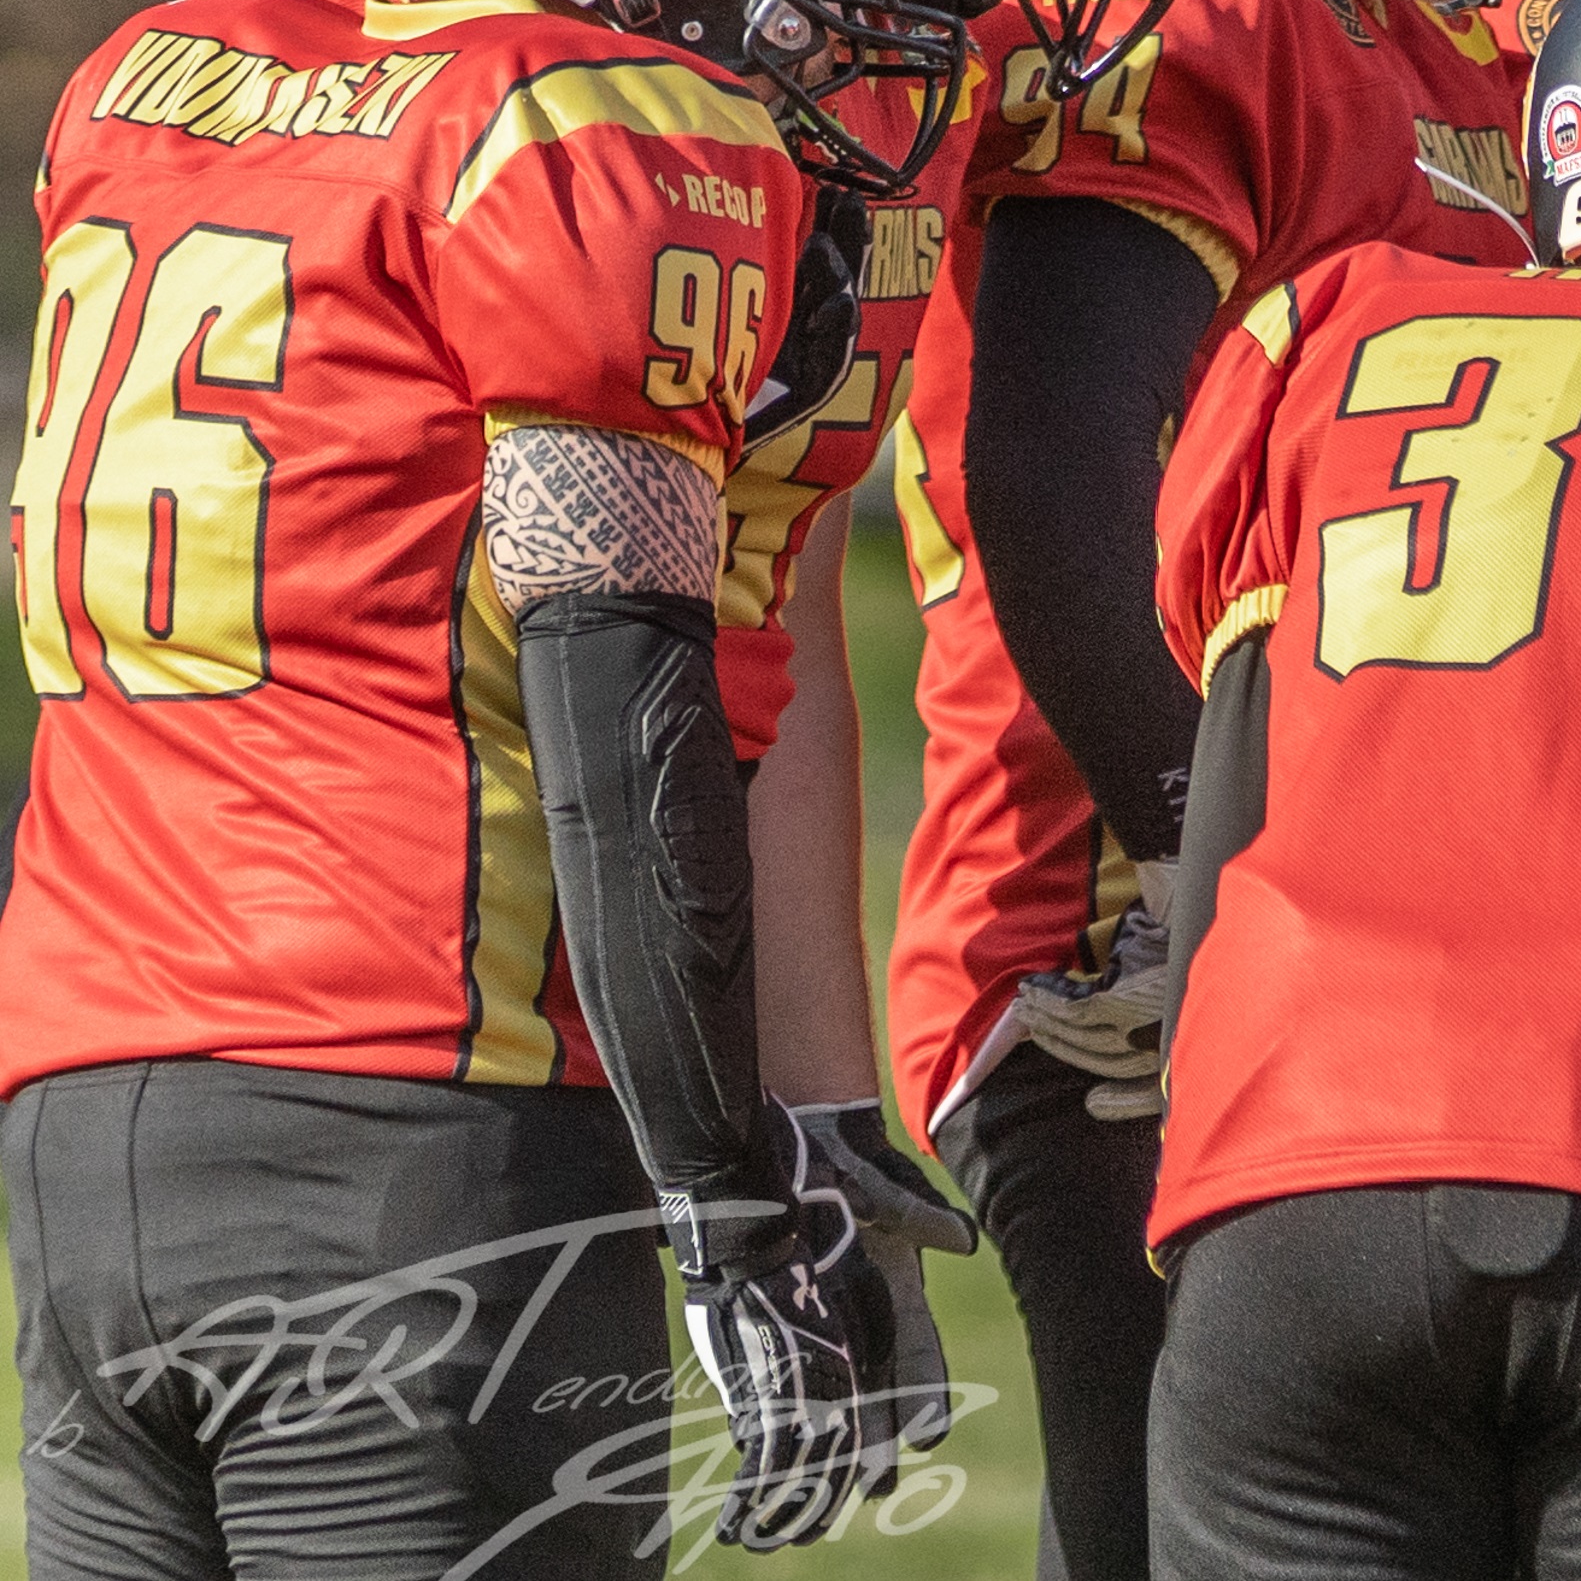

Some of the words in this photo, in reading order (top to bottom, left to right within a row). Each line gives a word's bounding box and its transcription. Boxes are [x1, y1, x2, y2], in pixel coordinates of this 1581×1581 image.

[999, 31, 1163, 175] 94
[681, 172, 766, 228] RECOP
[642, 243, 768, 427] 96
[5, 215, 295, 704] 96
